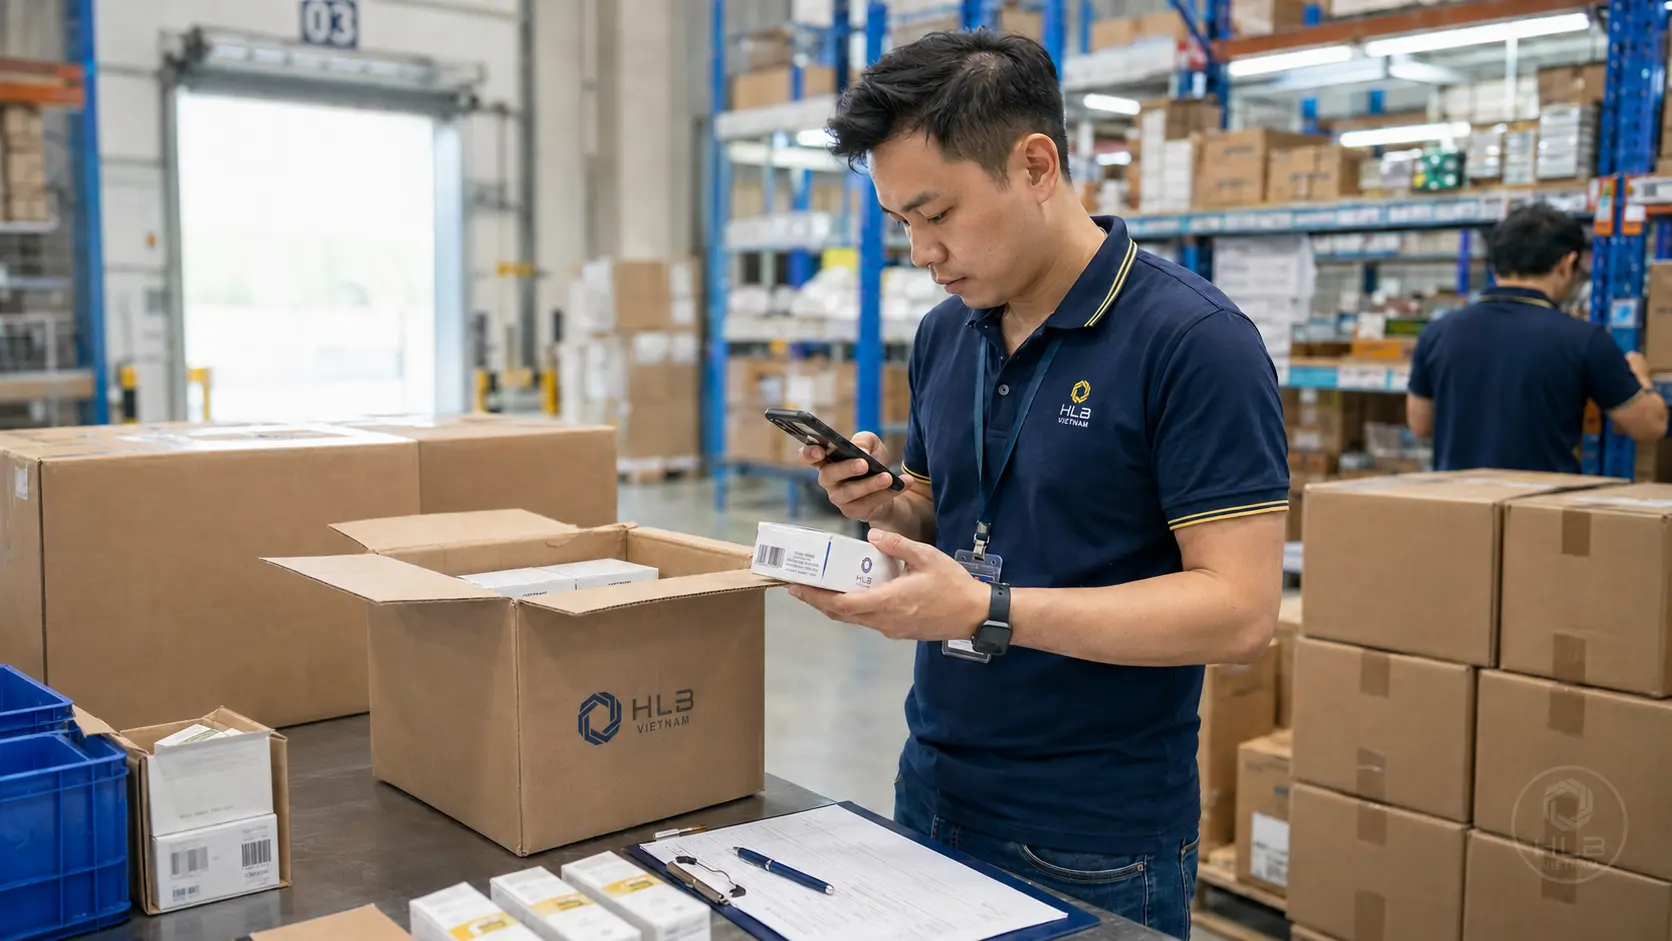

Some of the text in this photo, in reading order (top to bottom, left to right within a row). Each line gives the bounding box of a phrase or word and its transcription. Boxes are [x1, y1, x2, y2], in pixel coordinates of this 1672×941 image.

[306, 2, 354, 44] 03
[1060, 404, 1091, 419] HLB
[1058, 417, 1088, 427] VIETNAM
[632, 688, 694, 721] HLB
[637, 715, 690, 734] VIETNAM
